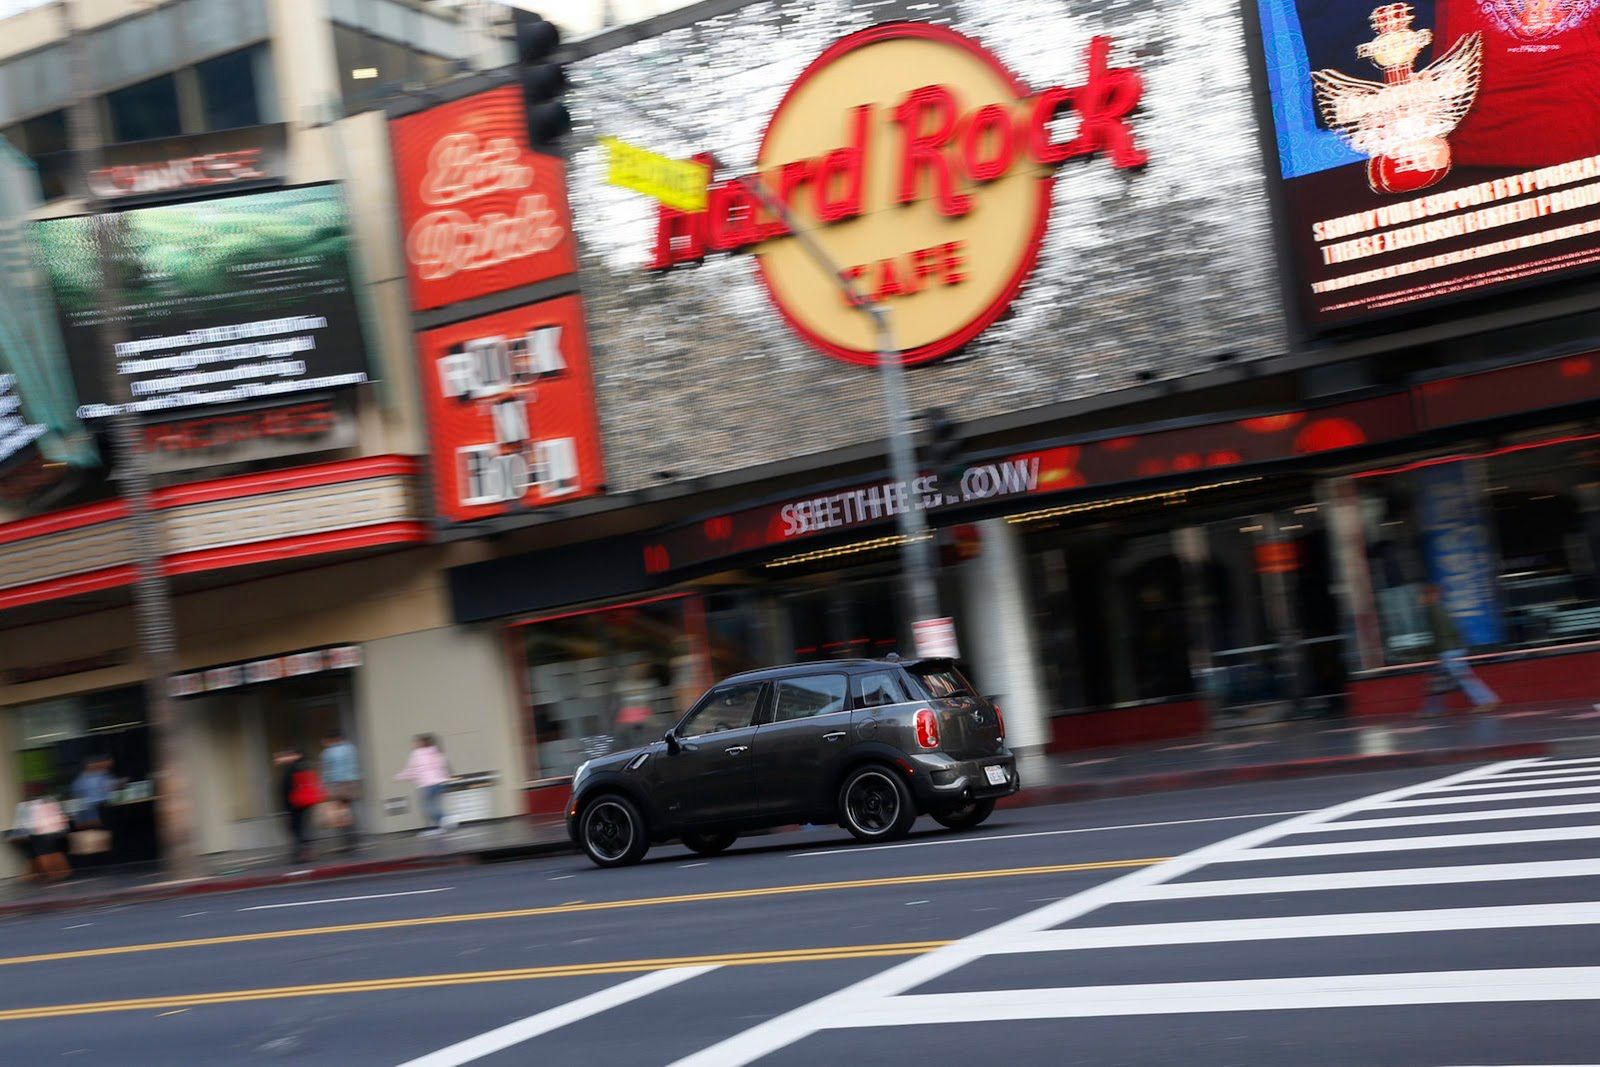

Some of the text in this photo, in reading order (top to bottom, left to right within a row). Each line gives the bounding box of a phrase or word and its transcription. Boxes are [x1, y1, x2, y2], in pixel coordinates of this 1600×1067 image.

[648, 36, 1147, 270] Hard Rock
[839, 240, 967, 306] CAFE
